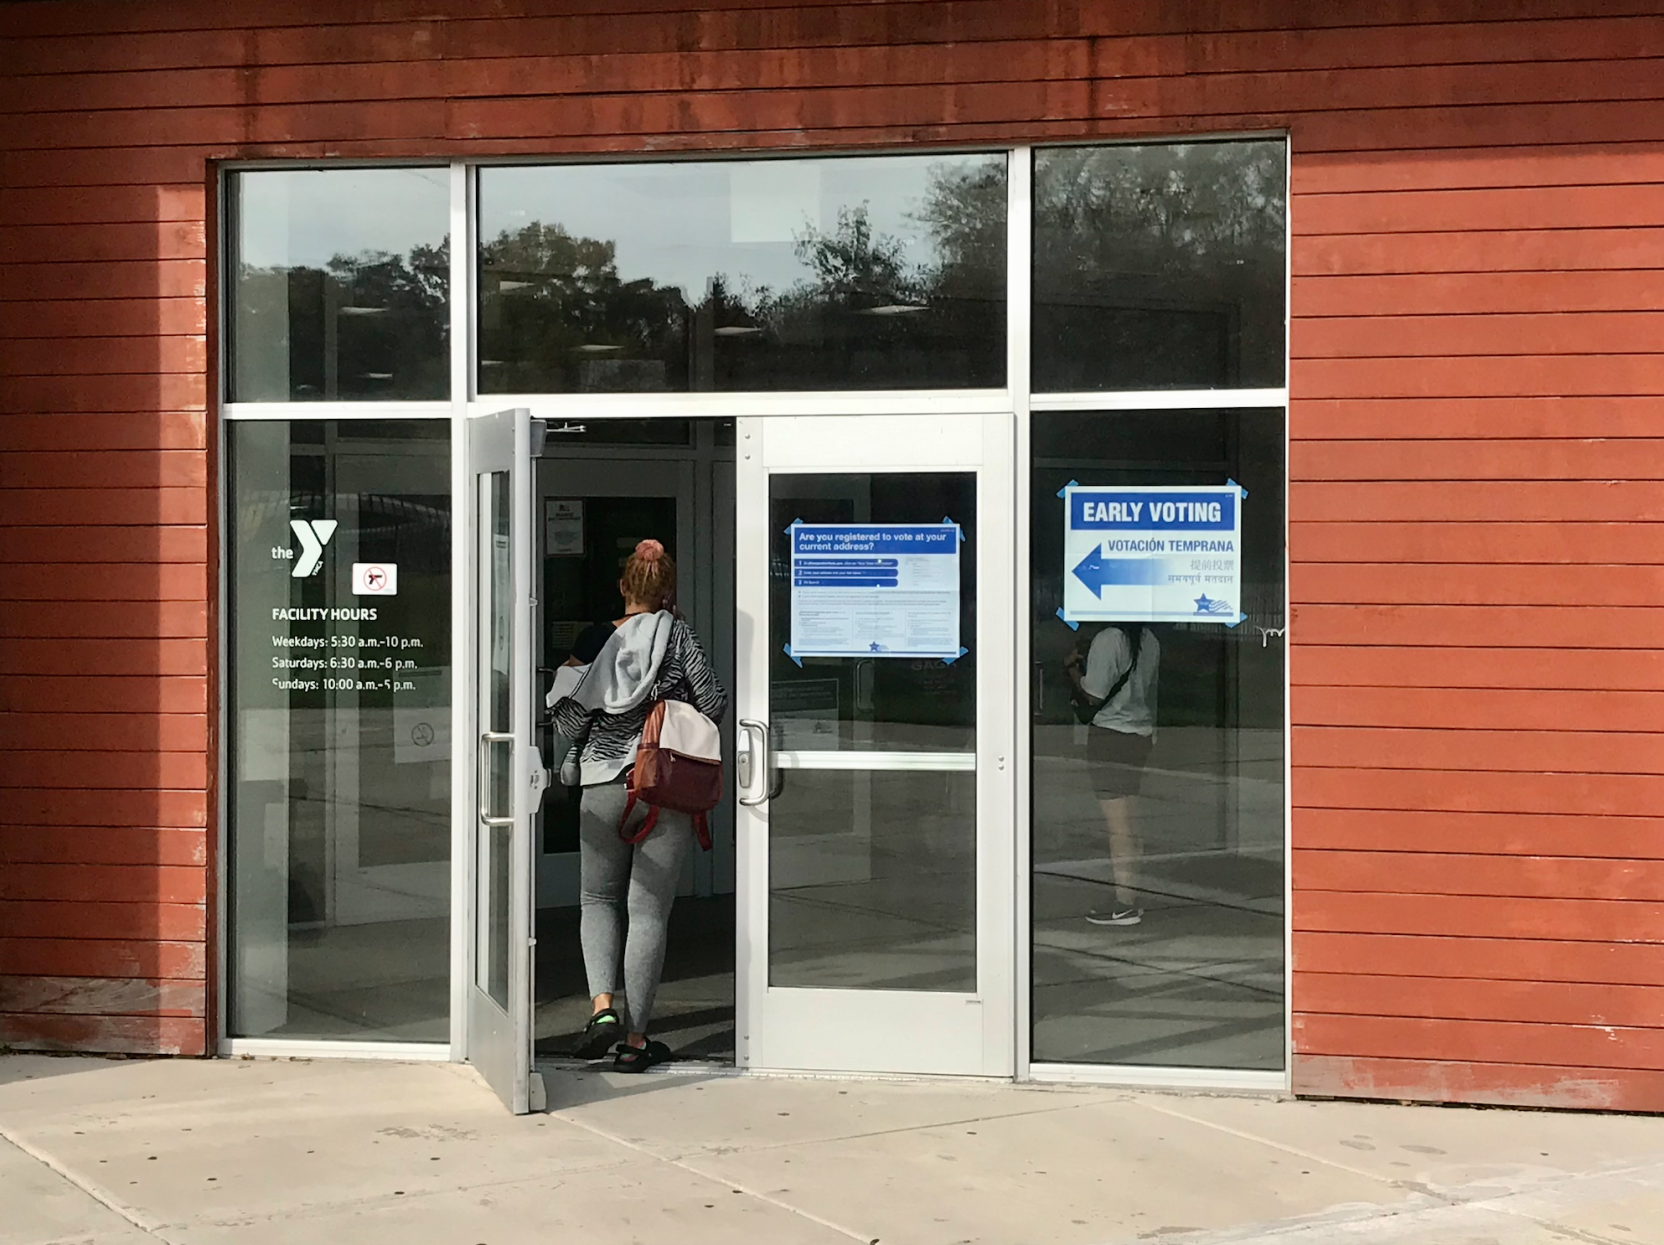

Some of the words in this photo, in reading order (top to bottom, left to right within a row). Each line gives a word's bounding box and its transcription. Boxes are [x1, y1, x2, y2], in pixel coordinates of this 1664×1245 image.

[1083, 502, 1144, 523] EARLY
[1149, 502, 1222, 523] VOTING
[798, 532, 815, 541] Are
[816, 534, 833, 543] you
[834, 532, 880, 543] registered
[882, 532, 892, 541] to
[893, 532, 914, 541] vote
[915, 533, 924, 541] at
[926, 533, 947, 543] your
[1108, 537, 1165, 552] VOTACIÓN
[1168, 540, 1234, 552] TEMPRANA
[271, 546, 294, 559] the
[799, 542, 832, 551] current
[833, 542, 875, 551] address?
[272, 608, 329, 621] FACILITY
[331, 608, 378, 621] HOURS
[272, 636, 329, 649] Weekdays:
[330, 636, 356, 647] 5:30
[401, 639, 424, 650] p.m.
[272, 657, 328, 671] Saturdays:
[330, 657, 355, 669] 6:30
[395, 660, 418, 671] p.m.
[323, 678, 353, 690] 10:00
[393, 682, 416, 693] p.m.
